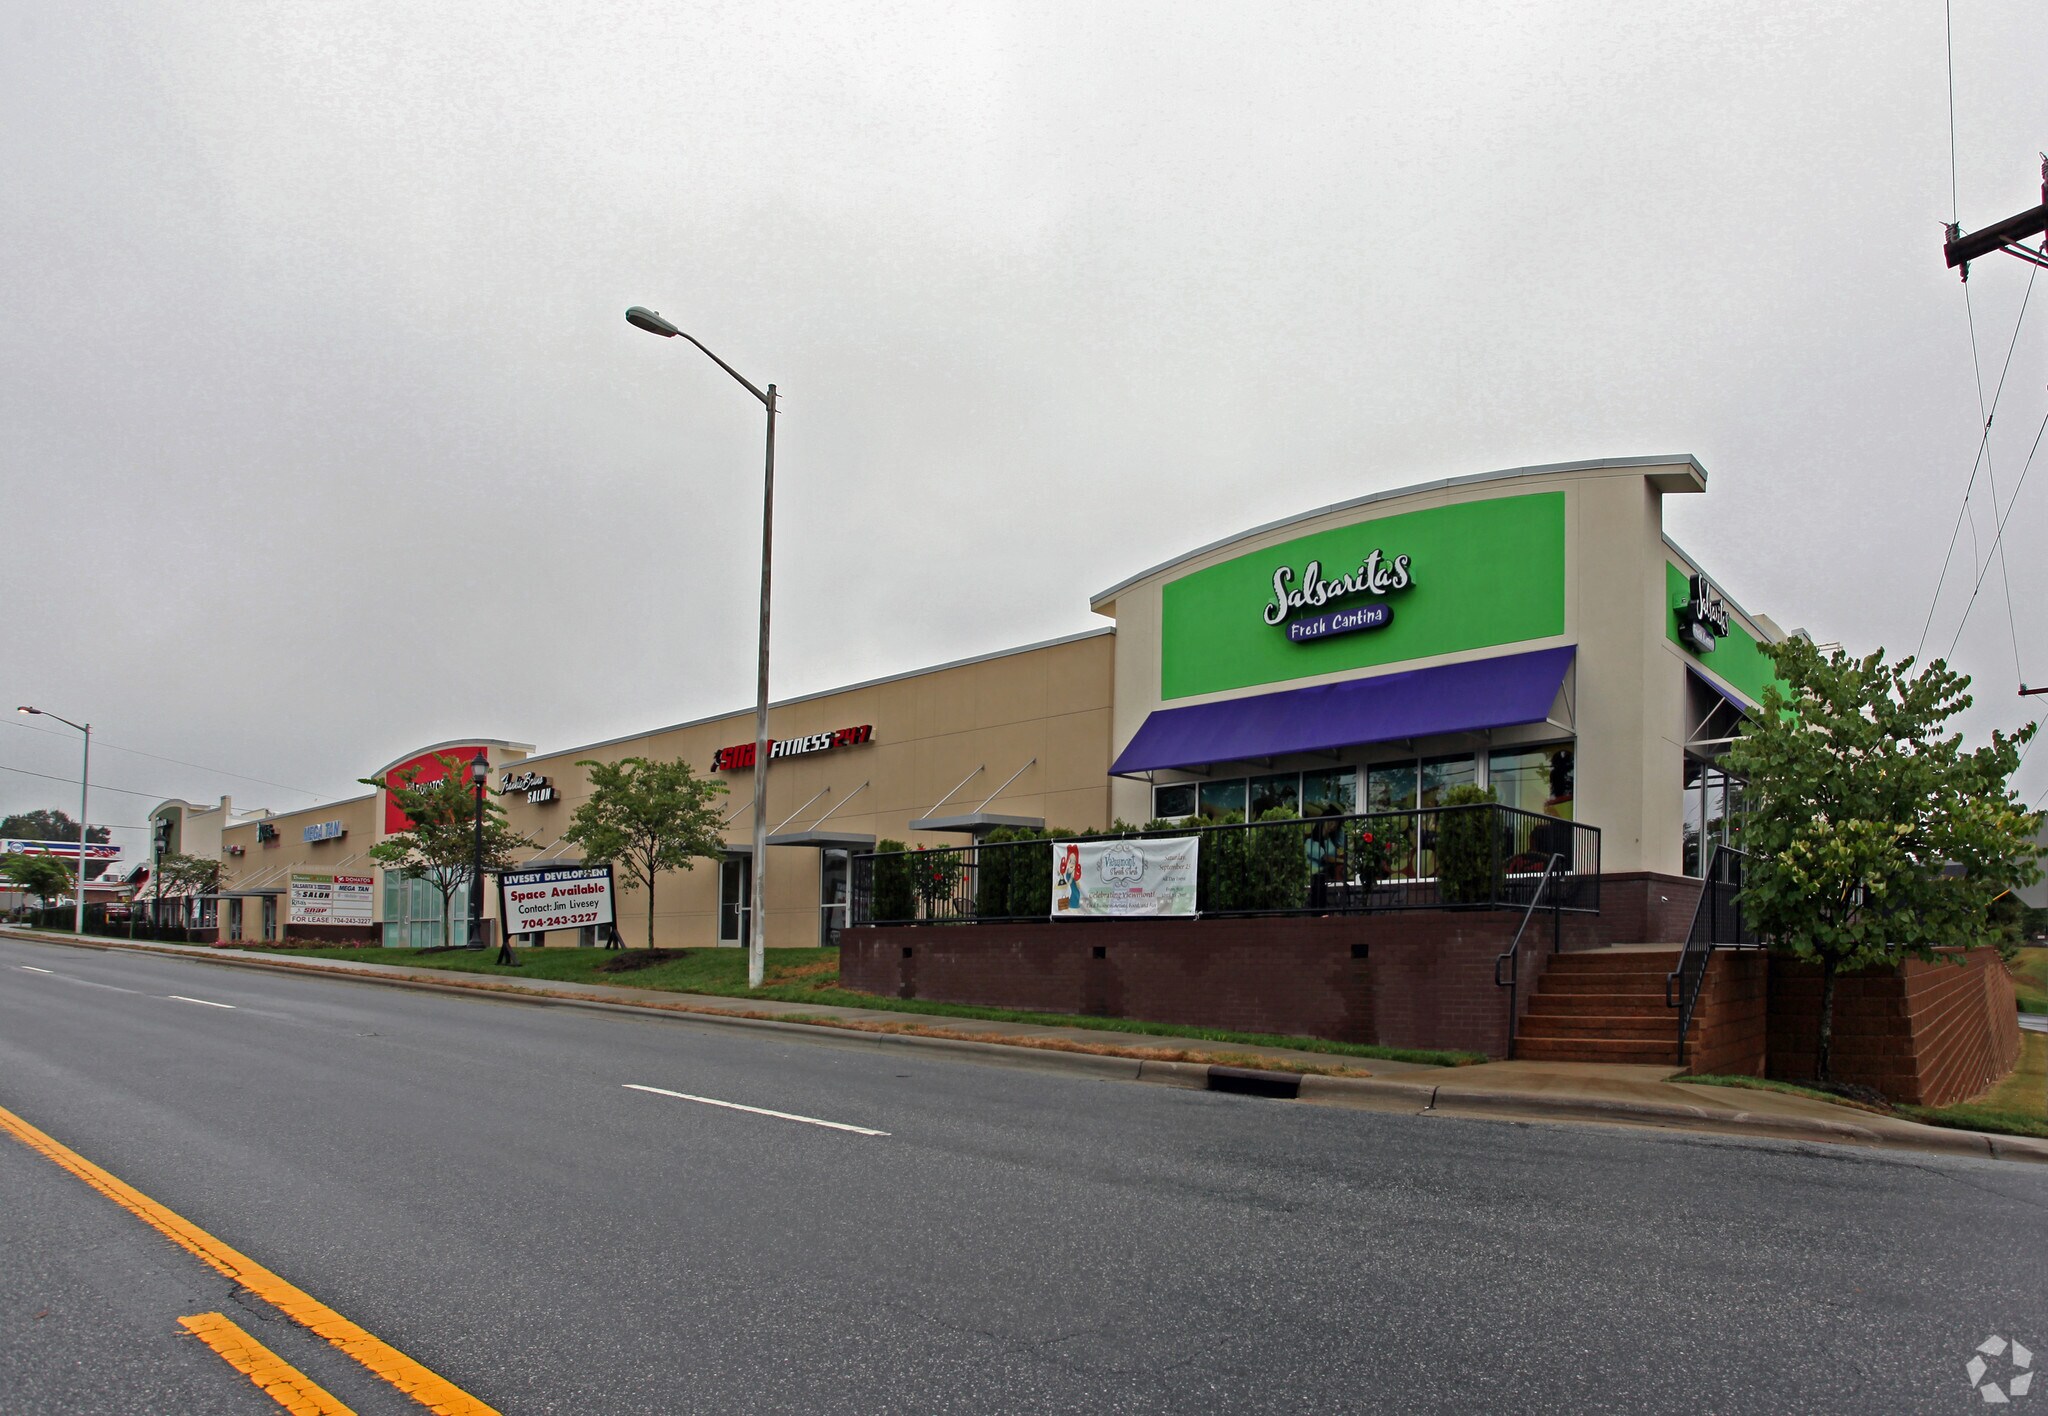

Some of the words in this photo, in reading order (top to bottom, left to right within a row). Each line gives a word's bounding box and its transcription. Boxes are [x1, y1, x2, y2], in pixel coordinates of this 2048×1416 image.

[1291, 617, 1326, 639] Fresh
[1332, 608, 1383, 630] Cantina
[770, 731, 833, 758] FITNESS
[527, 787, 552, 804] SALON
[503, 873, 542, 885] LIVESEY
[302, 891, 330, 899] SALON
[510, 890, 546, 903] Space
[551, 883, 605, 898] Available
[518, 903, 552, 915] Contact:
[553, 901, 567, 911] Jim
[569, 899, 600, 911] Livesey
[308, 916, 330, 924] LEASE
[333, 917, 372, 925] 704-243-3227
